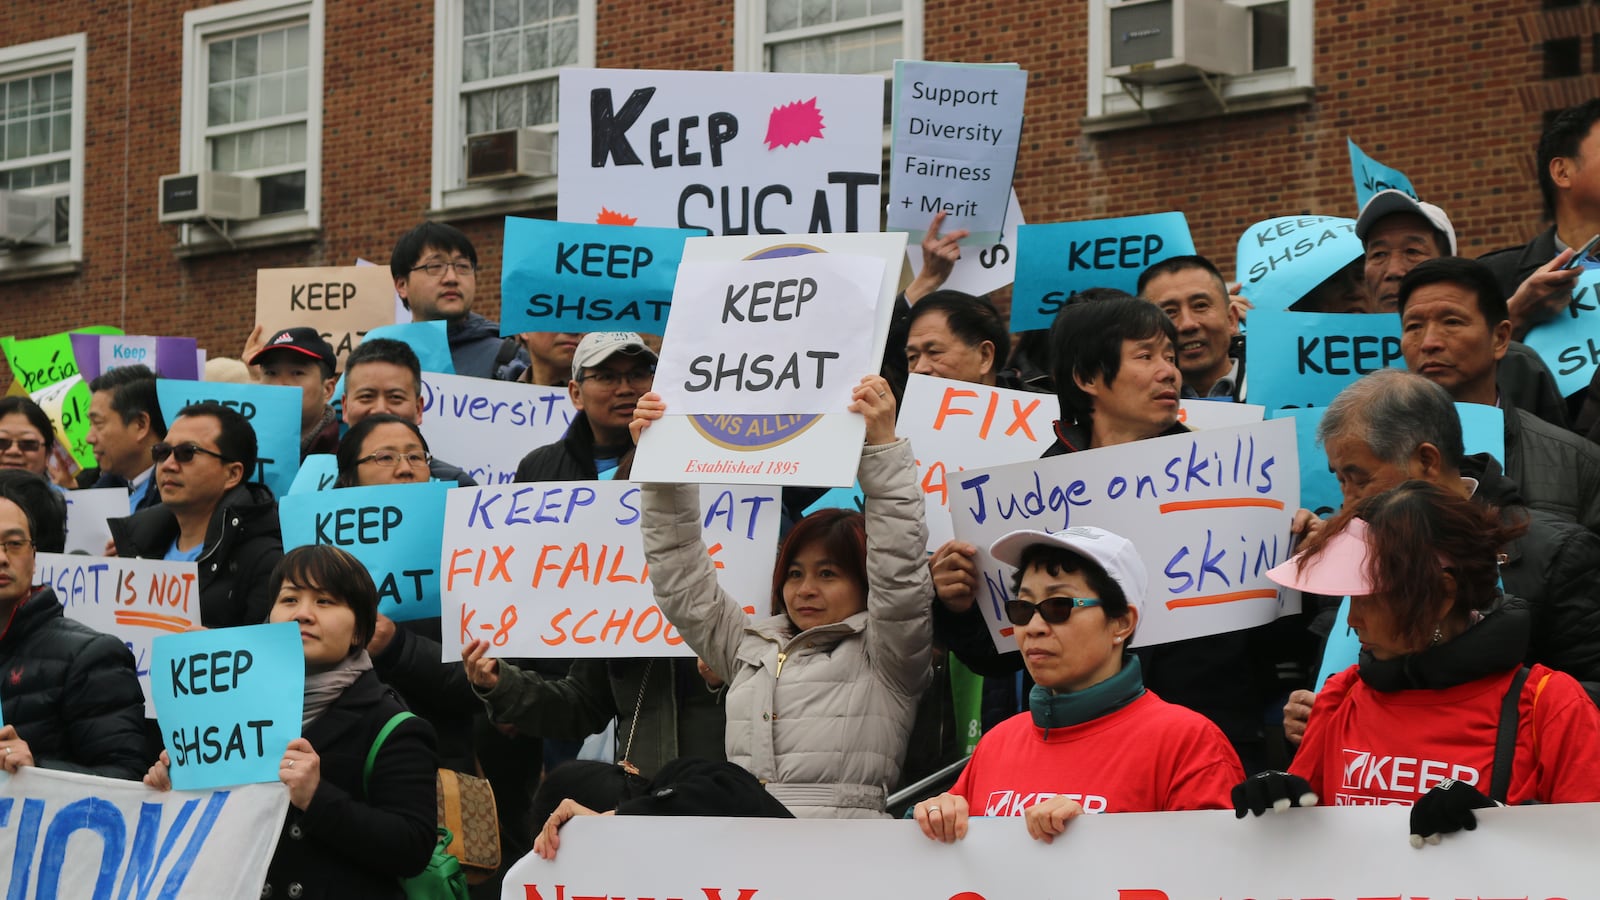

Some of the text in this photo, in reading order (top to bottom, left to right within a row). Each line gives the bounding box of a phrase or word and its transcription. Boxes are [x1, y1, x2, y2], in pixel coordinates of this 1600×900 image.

[911, 81, 999, 107] Support
[908, 117, 1003, 146] Diversity
[904, 156, 992, 181] Fairness
[920, 195, 979, 217] Merit
[555, 242, 654, 279] KEEP
[1067, 234, 1164, 271] KEEP
[1249, 223, 1355, 284] SHSAT
[289, 282, 357, 312] KEEP
[526, 293, 671, 321] SHSAT
[721, 277, 818, 324] KEEP
[113, 343, 147, 360] Keep
[684, 350, 840, 393] SHSAT
[1297, 335, 1403, 375] KEEP
[932, 387, 1042, 442] FIX
[685, 459, 800, 475] Established 1895
[467, 487, 597, 530] KEEP
[960, 470, 1093, 533] Judge
[1107, 476, 1158, 500] on
[316, 506, 403, 546] KEEP
[447, 545, 516, 592] FIX
[115, 568, 138, 606] IS
[148, 572, 196, 614] NOT
[460, 602, 518, 647] K-8
[170, 649, 253, 698] KEEP
[172, 719, 274, 767] SHSAT
[1364, 755, 1480, 795] KEEP
